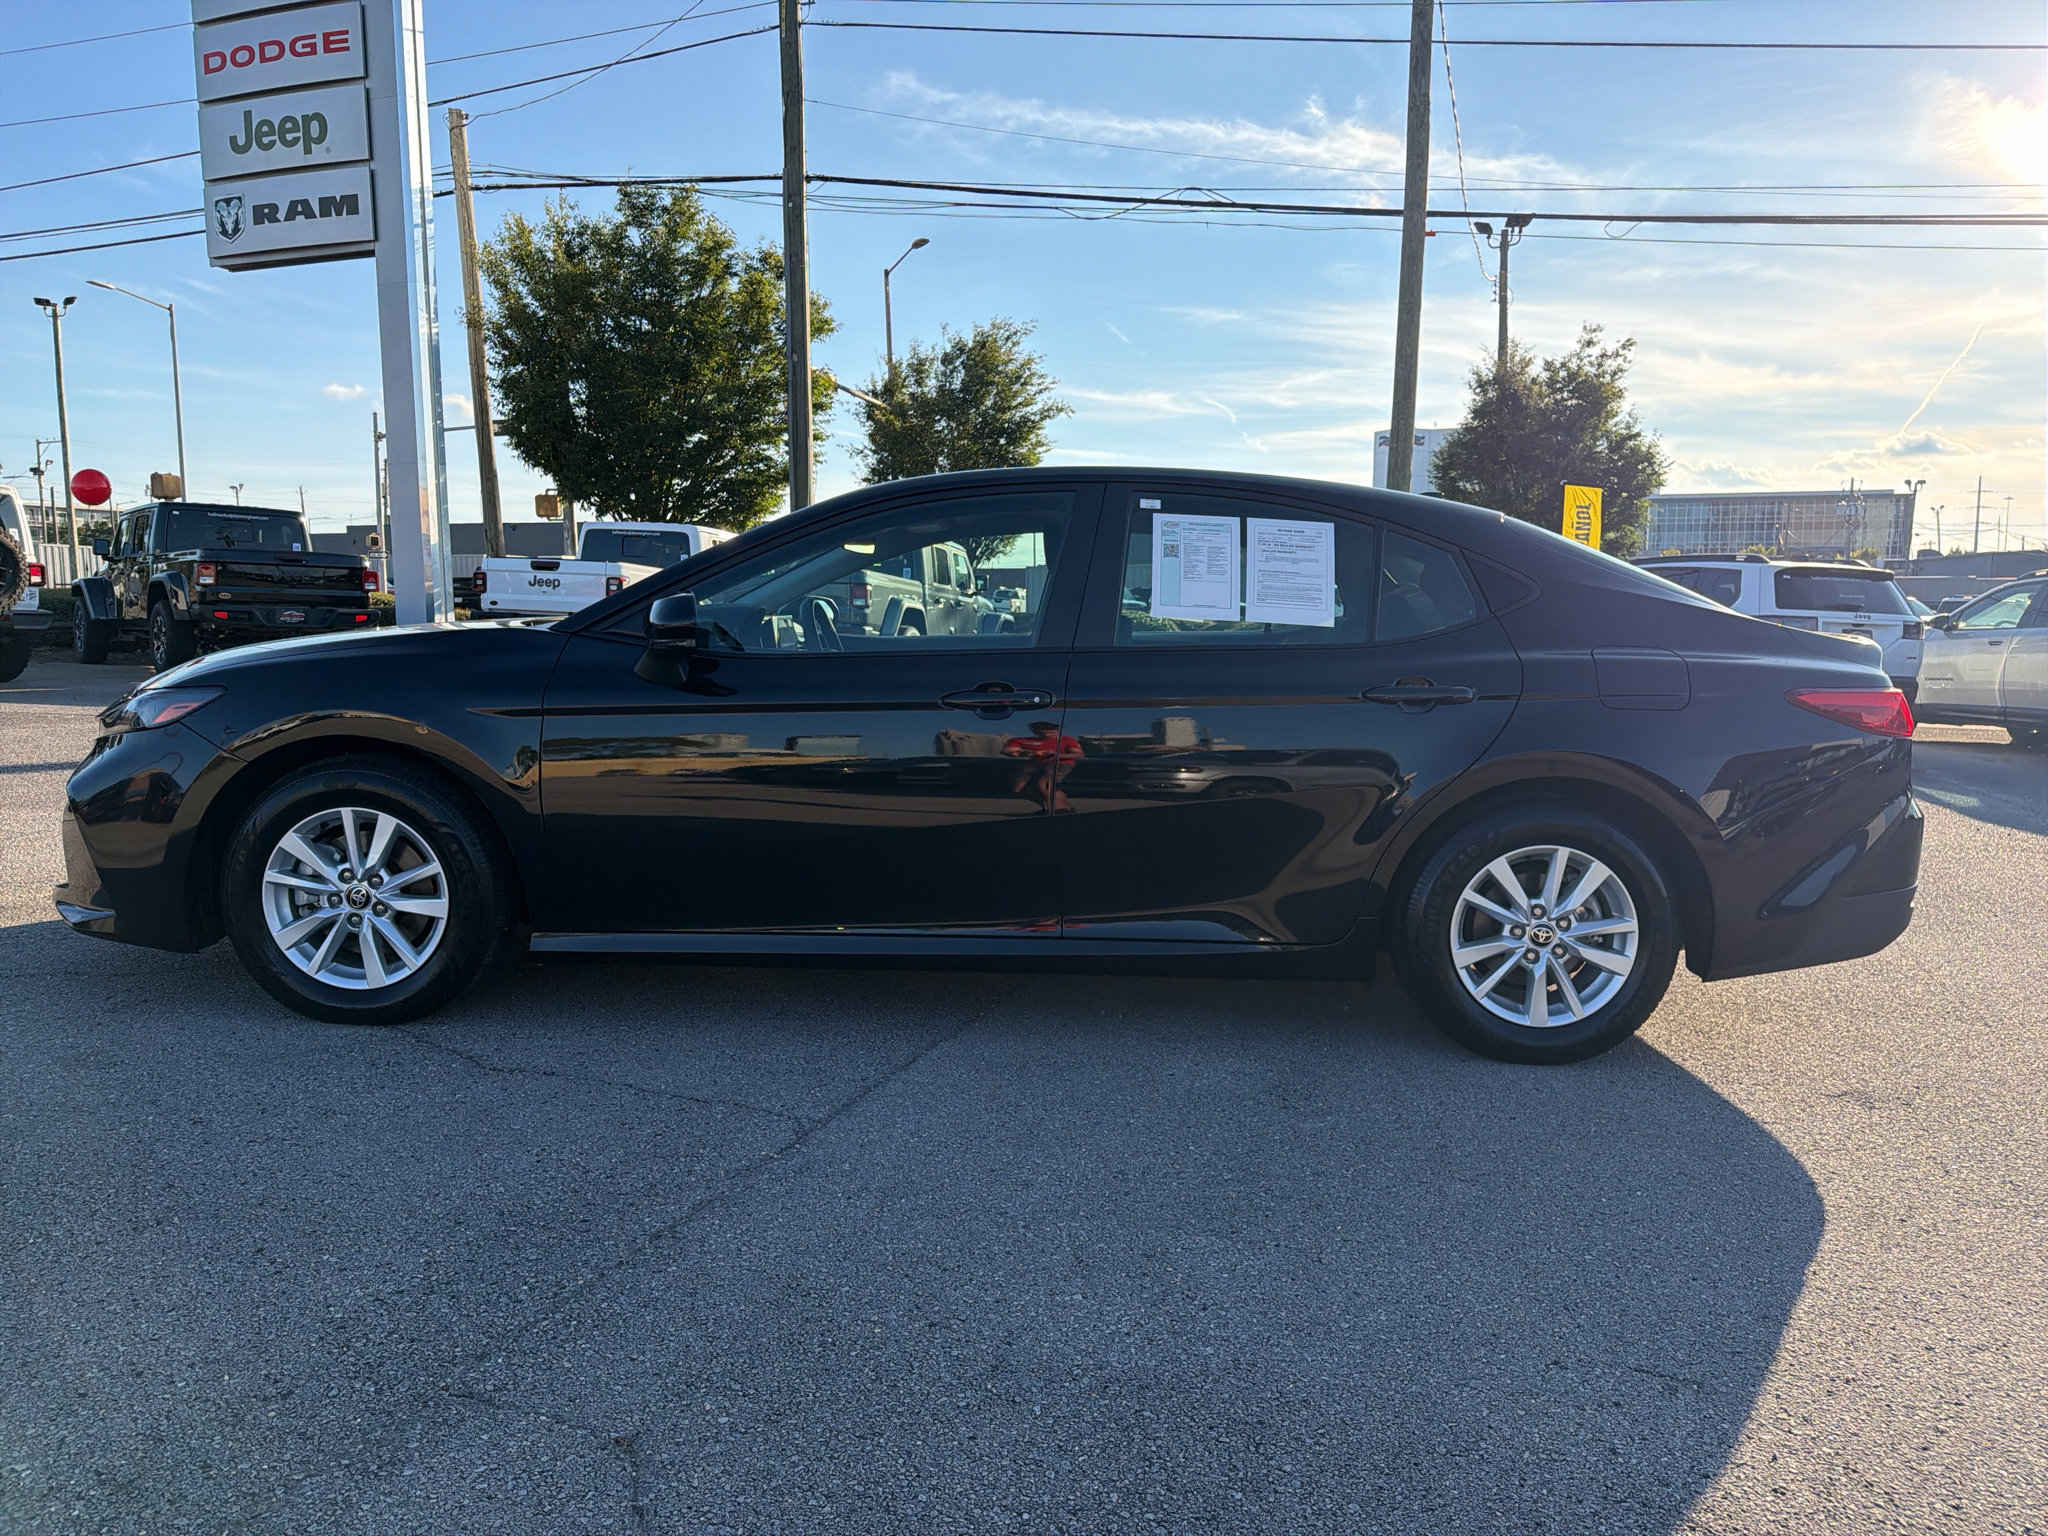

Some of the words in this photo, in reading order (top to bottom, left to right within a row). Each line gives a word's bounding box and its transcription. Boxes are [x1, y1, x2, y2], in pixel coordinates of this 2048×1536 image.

[203, 29, 351, 75] DODGE
[229, 109, 328, 156] Jeep
[252, 193, 360, 226] RAM
[1571, 503, 1592, 545] AÑOL
[528, 574, 561, 590] Jeep
[1853, 613, 1872, 621] Jeep
